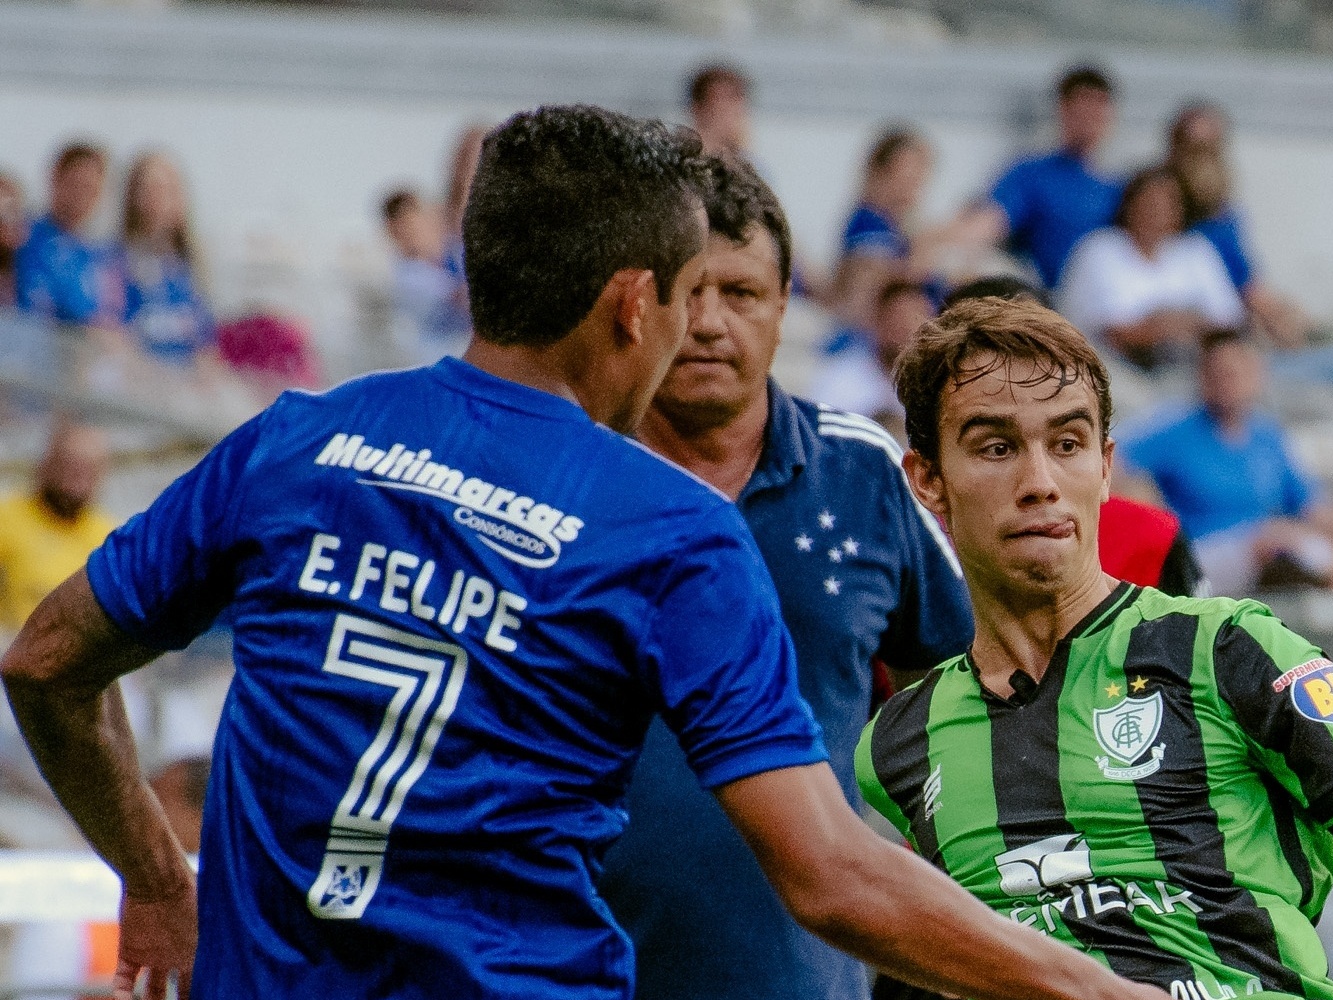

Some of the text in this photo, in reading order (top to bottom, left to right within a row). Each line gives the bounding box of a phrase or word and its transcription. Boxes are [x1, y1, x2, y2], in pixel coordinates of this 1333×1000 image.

[314, 433, 585, 542] Multimarcas
[299, 532, 528, 652] E. FELIPE
[303, 613, 469, 920] 7
